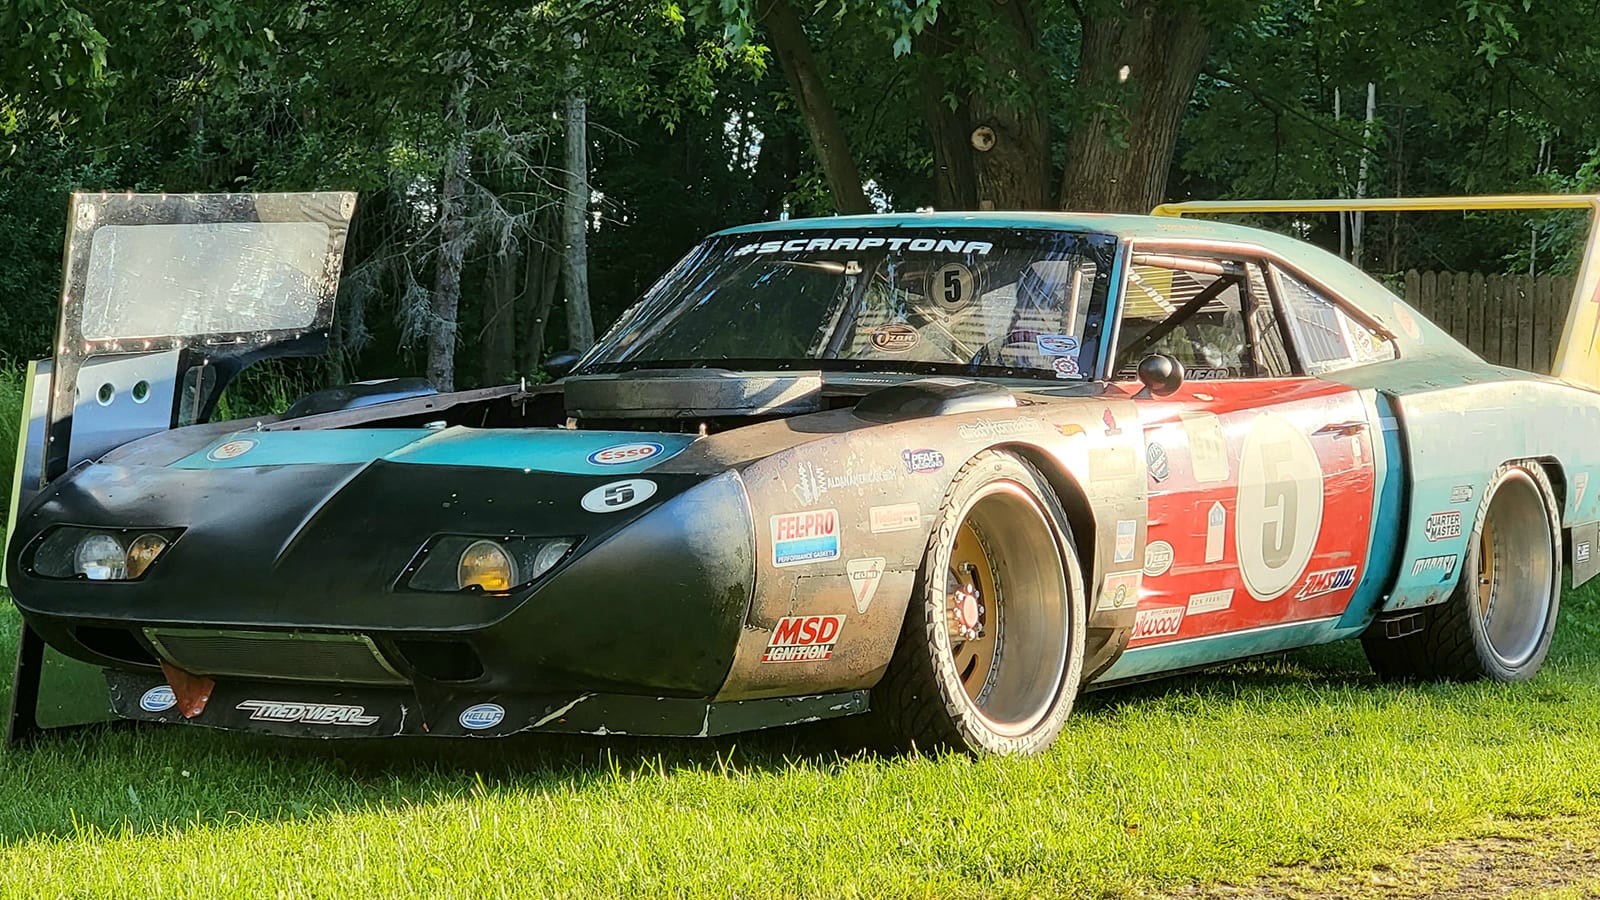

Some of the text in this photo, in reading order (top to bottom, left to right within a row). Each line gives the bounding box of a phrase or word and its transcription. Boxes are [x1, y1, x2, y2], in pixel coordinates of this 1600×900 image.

[733, 237, 994, 257] #SCRAPTONA
[942, 269, 962, 303] 5
[912, 451, 942, 462] PFAFF
[604, 483, 635, 506] 5
[1259, 440, 1298, 570] 5
[776, 511, 835, 540] FEL-PRO
[1426, 514, 1460, 530] QUARTER
[1430, 524, 1460, 539] MASTER
[1298, 568, 1355, 597] AMSOIL
[772, 617, 839, 645] MSD
[767, 645, 830, 661] IGNITION
[464, 712, 503, 721] HELLA
